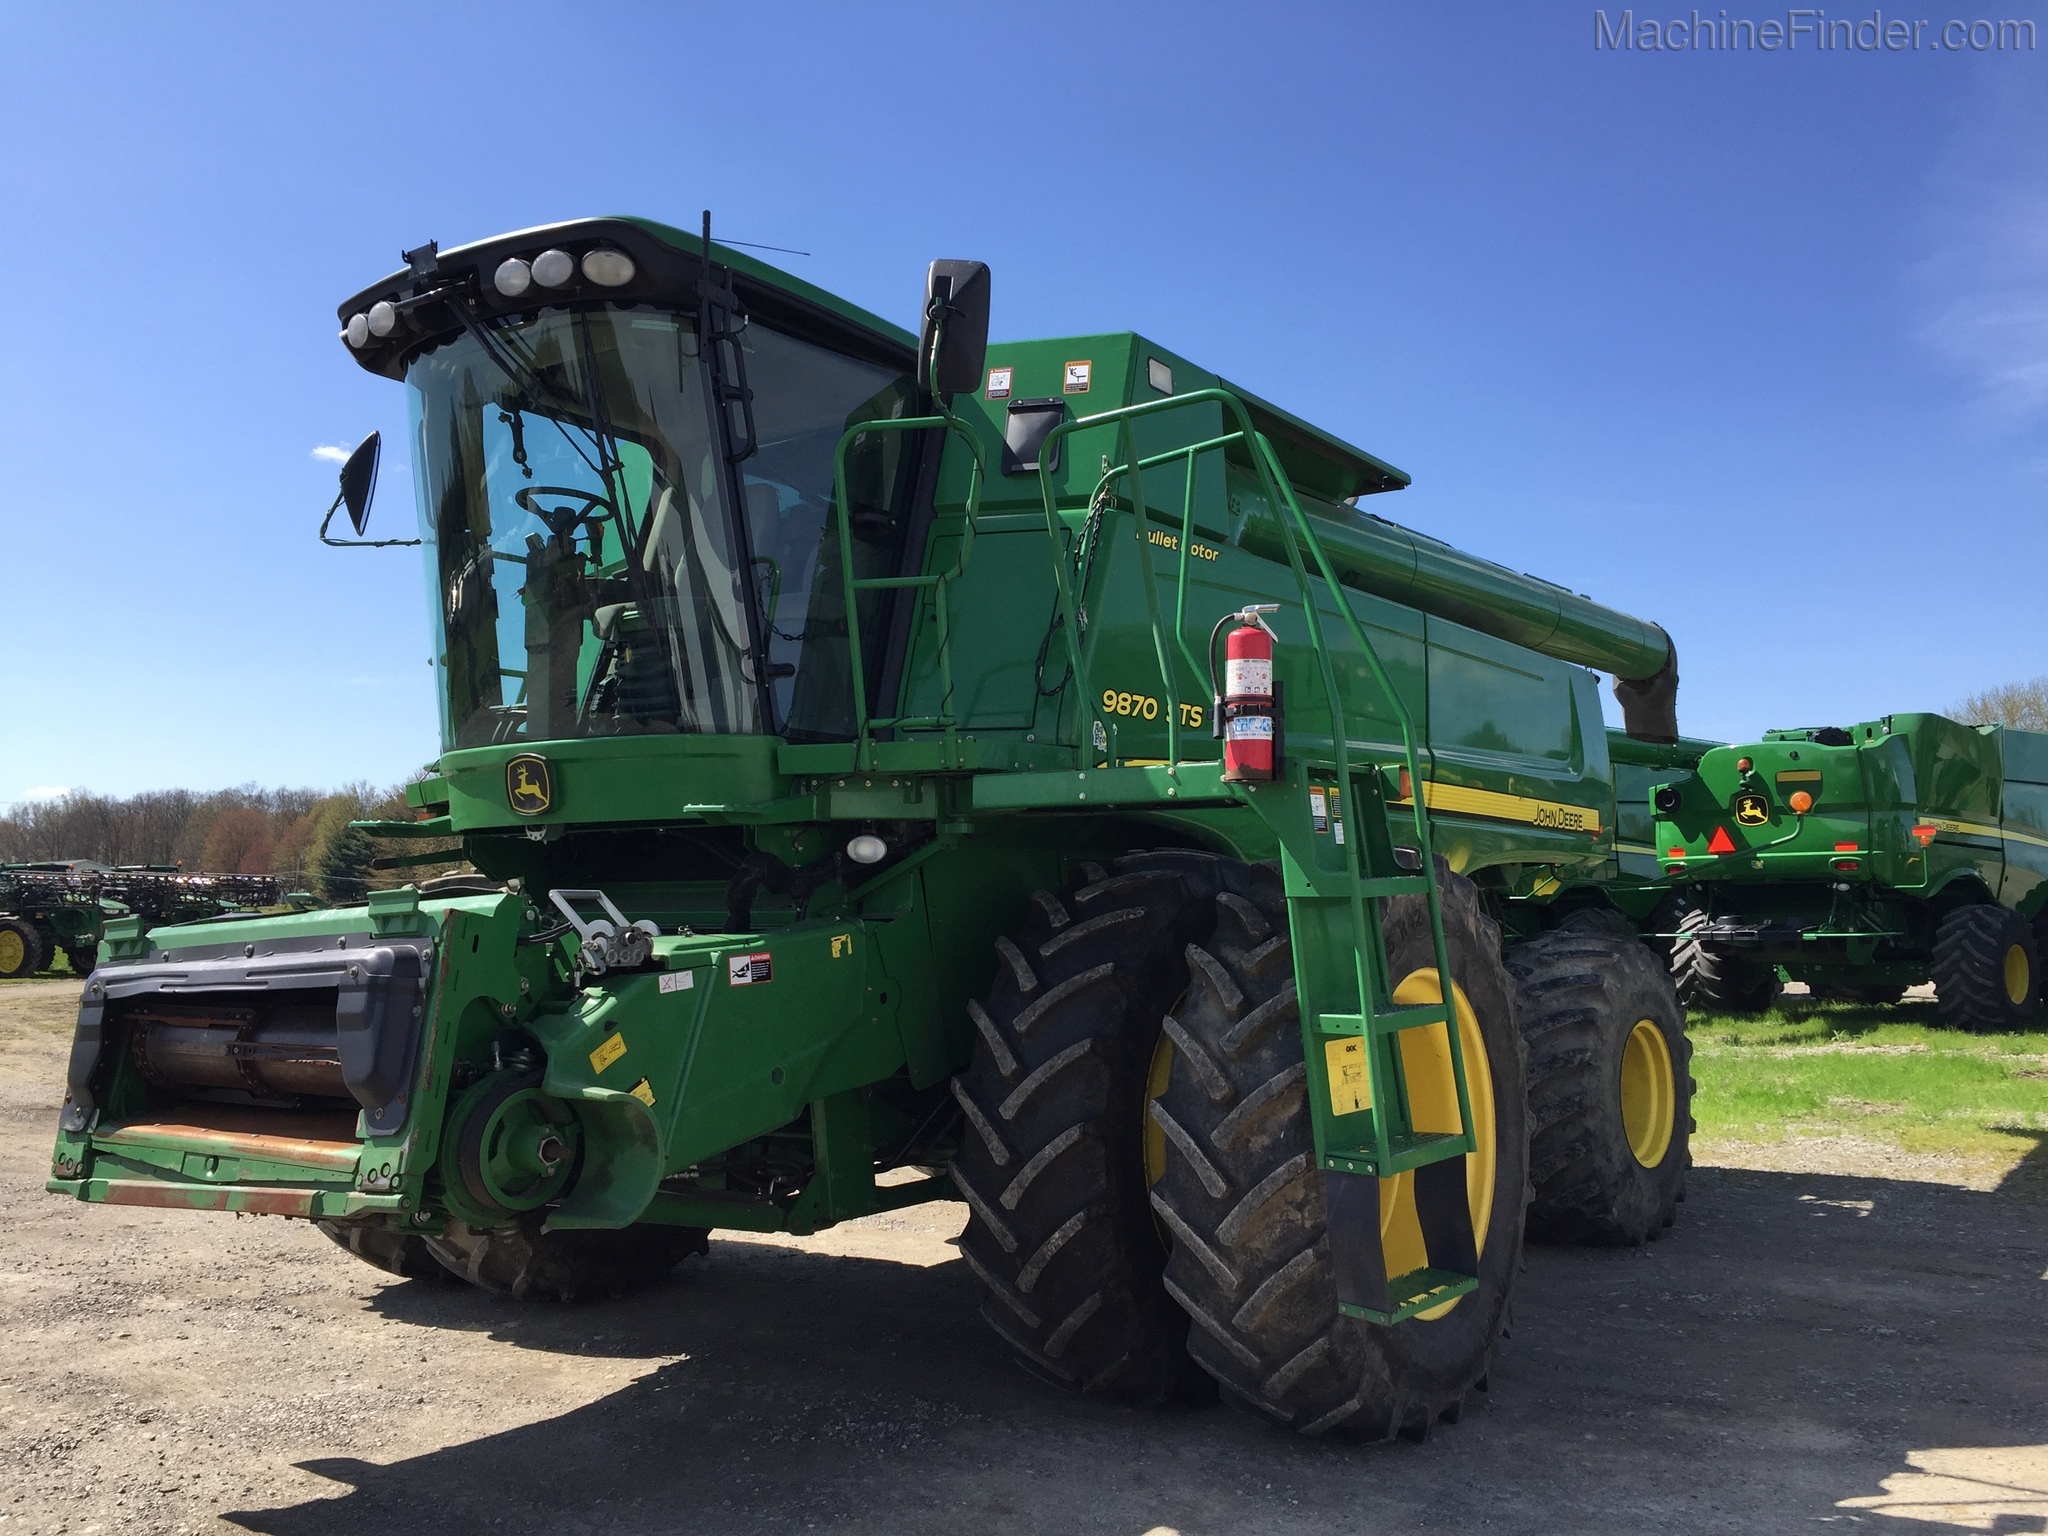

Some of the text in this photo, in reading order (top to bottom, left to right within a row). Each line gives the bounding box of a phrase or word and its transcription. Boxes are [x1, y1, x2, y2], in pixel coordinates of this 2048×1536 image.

[1136, 530, 1219, 561] ullet otor
[1102, 689, 1203, 728] 9870 TS
[1533, 804, 1583, 829] JOHN DEERE
